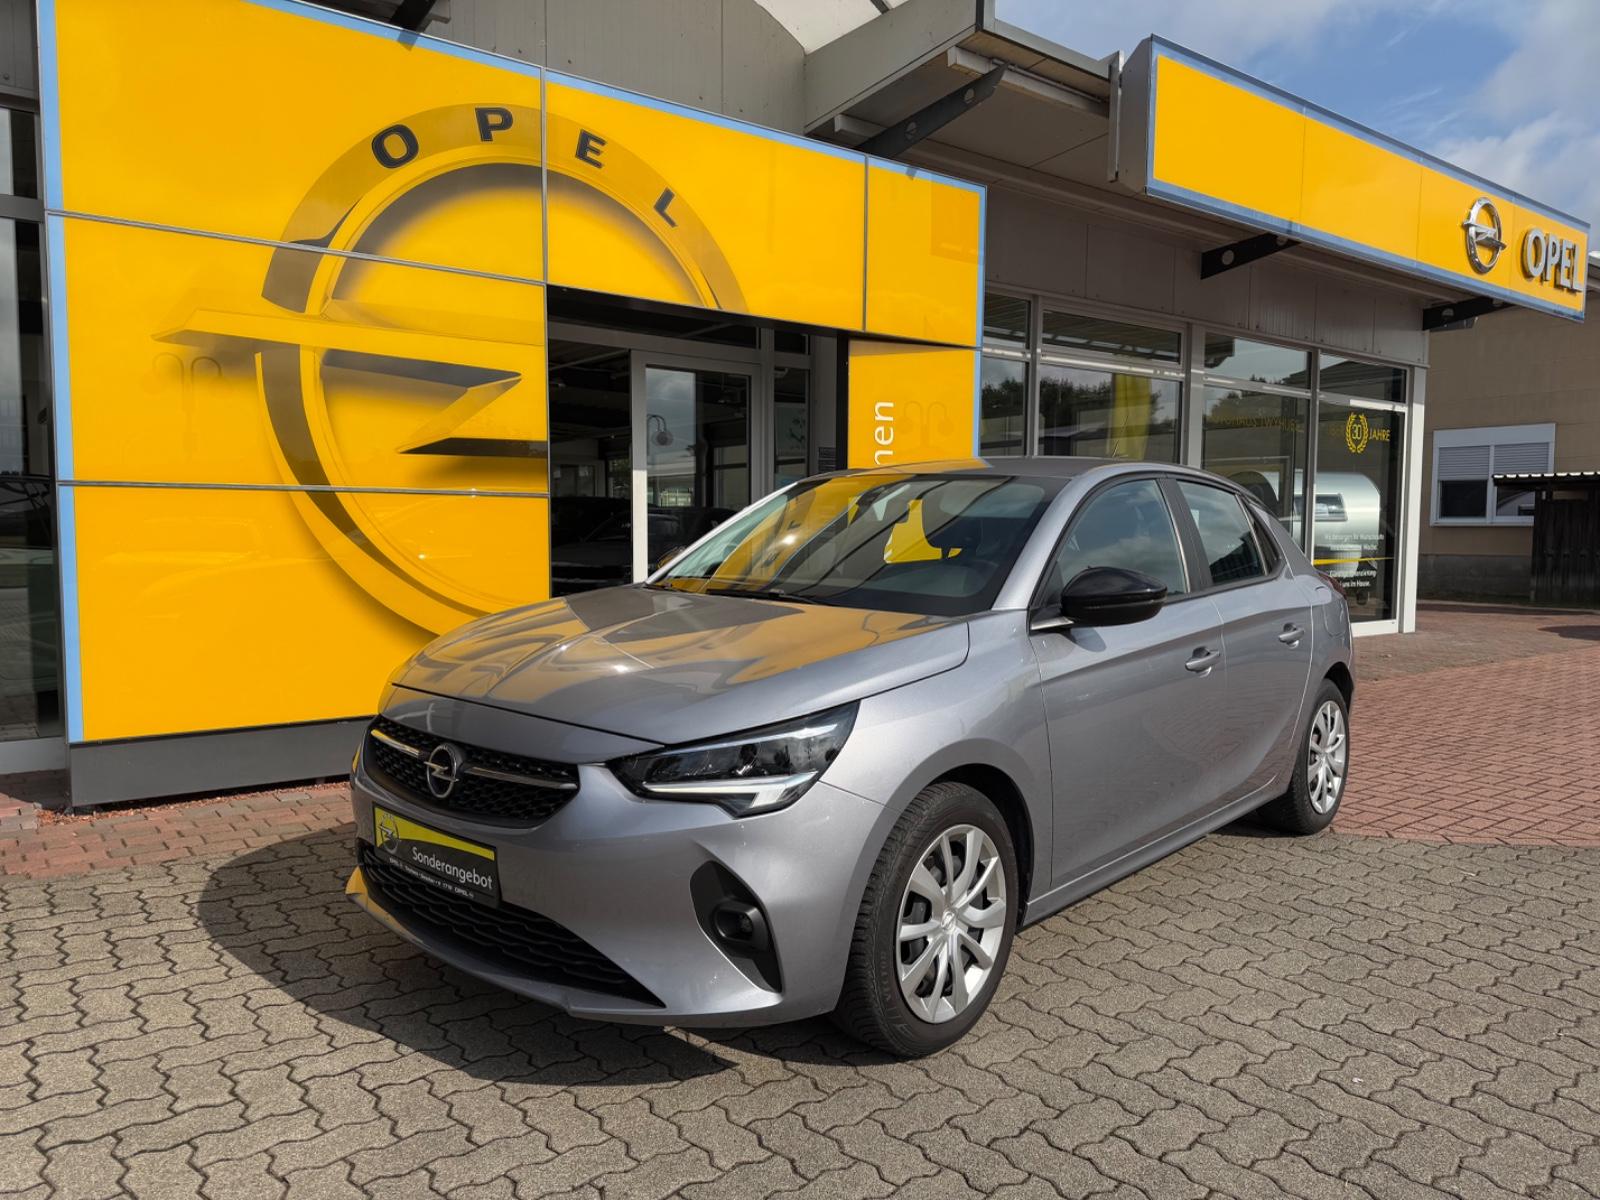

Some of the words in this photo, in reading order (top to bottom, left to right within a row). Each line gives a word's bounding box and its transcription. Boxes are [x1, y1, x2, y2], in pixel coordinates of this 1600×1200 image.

[371, 107, 678, 228] OPEL
[1521, 228, 1583, 292] OPEL
[1352, 424, 1362, 440] 30
[1369, 427, 1390, 441] JAHRE
[412, 846, 493, 890] Sonderangebot
